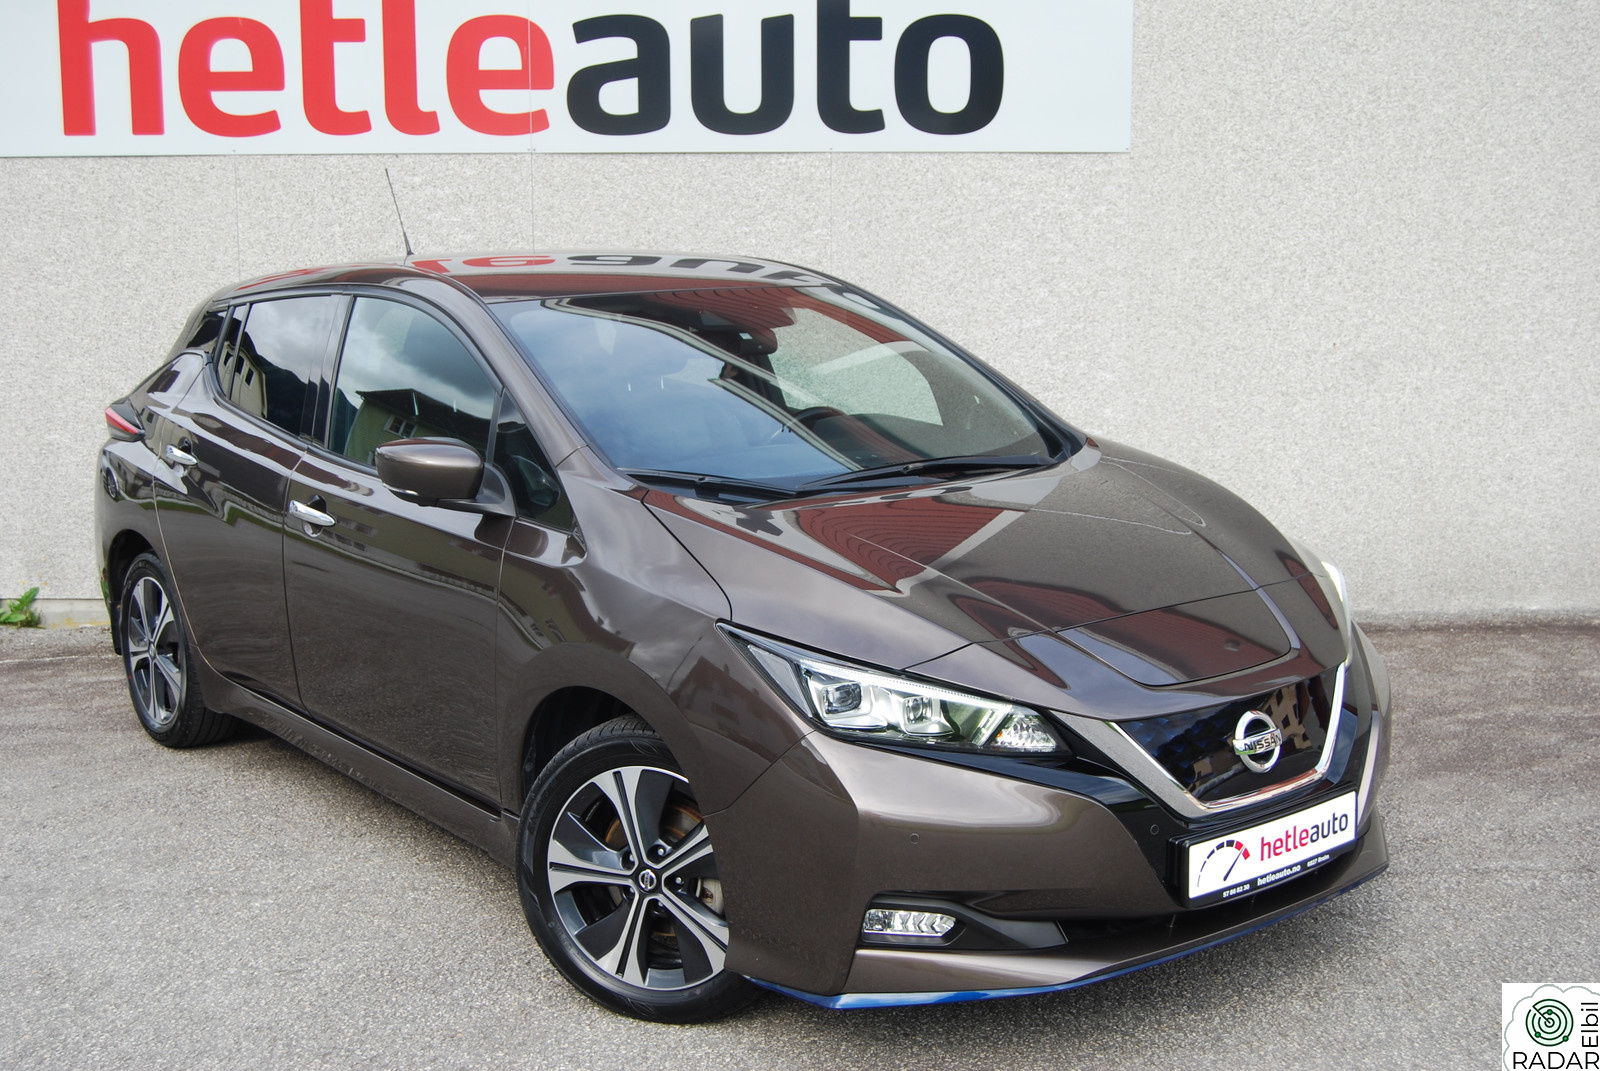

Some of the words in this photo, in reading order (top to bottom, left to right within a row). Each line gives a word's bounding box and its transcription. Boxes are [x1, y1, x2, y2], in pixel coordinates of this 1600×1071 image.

[57, 0, 1004, 137] hetleauto
[1244, 734, 1281, 751] NISSAN
[1260, 812, 1349, 861] hetleauto
[1257, 864, 1301, 886] hetleauto.no
